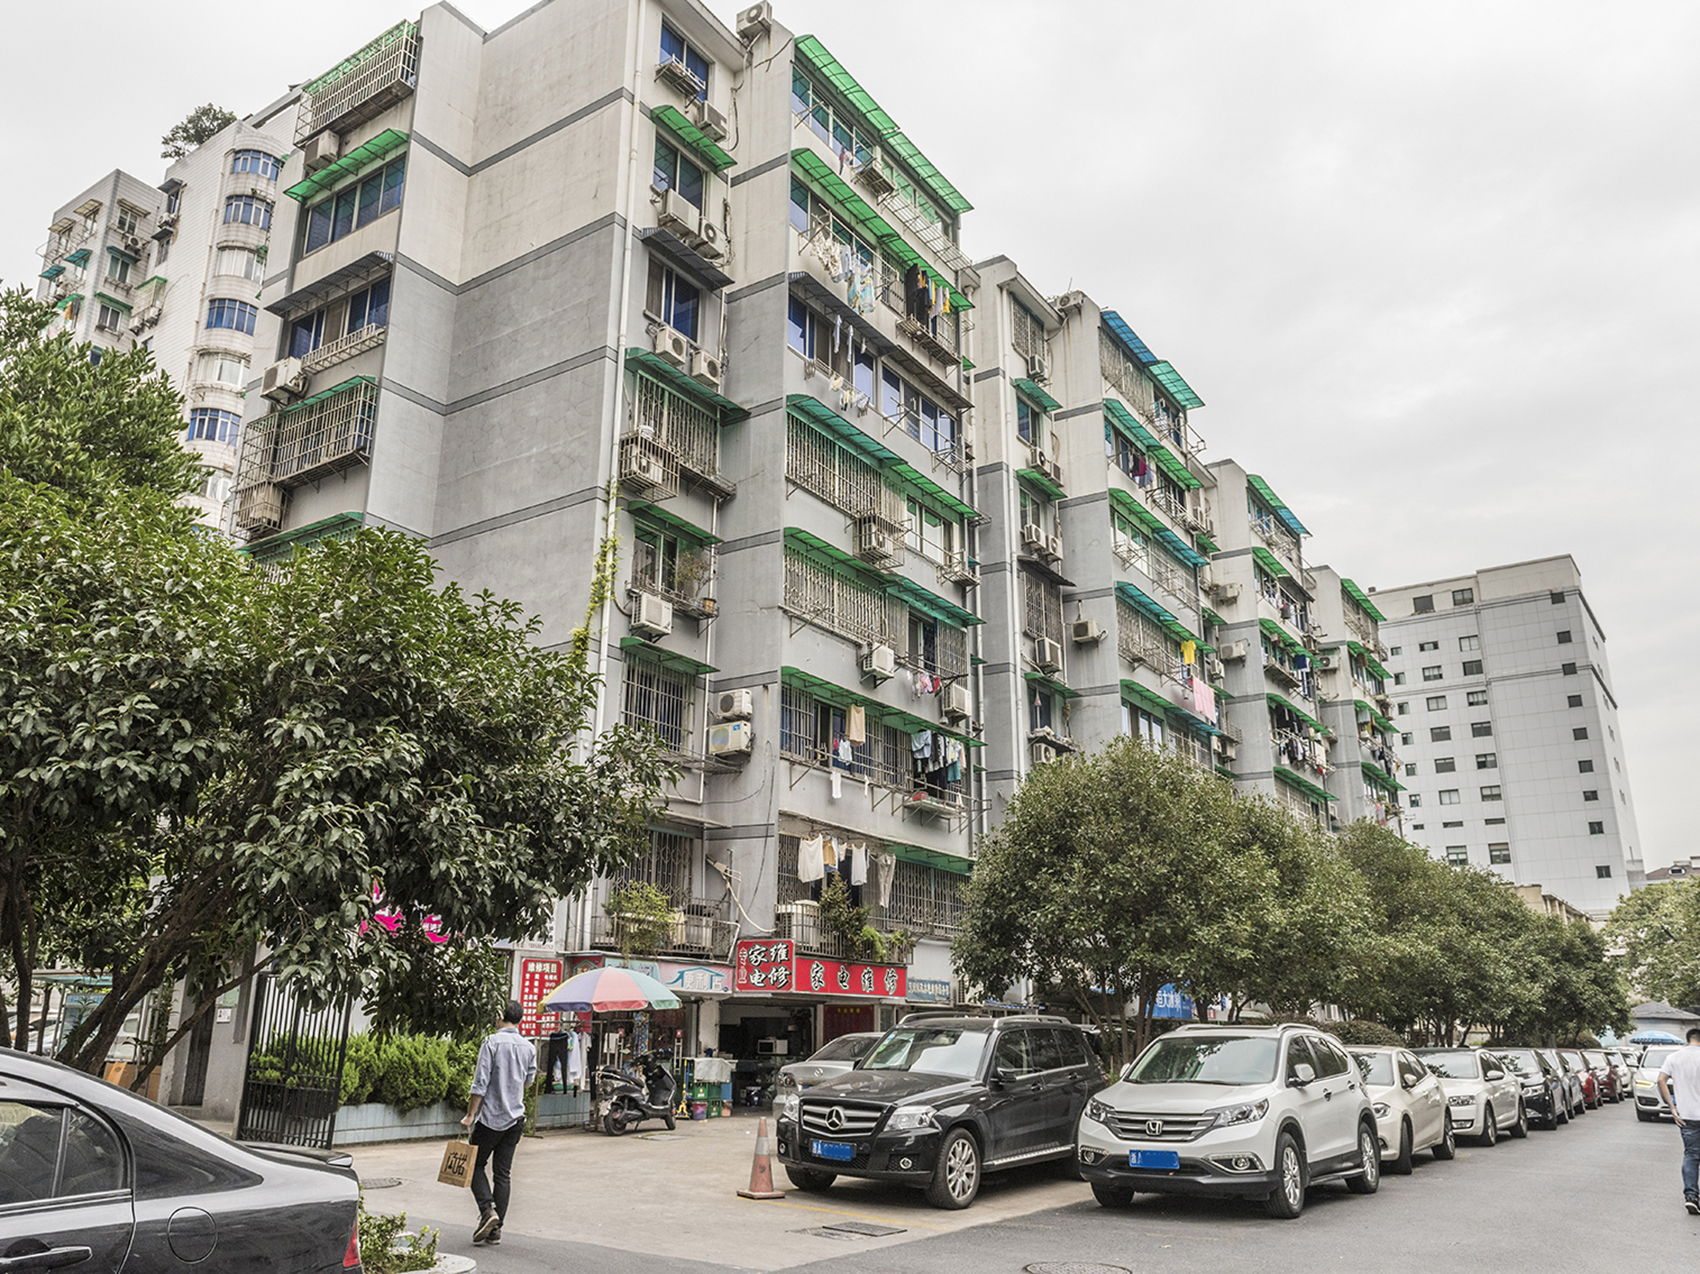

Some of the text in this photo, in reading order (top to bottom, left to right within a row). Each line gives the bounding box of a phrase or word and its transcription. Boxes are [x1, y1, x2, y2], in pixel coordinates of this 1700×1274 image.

[527, 962, 558, 973] 维修项目
[810, 961, 898, 995] 家电维修
